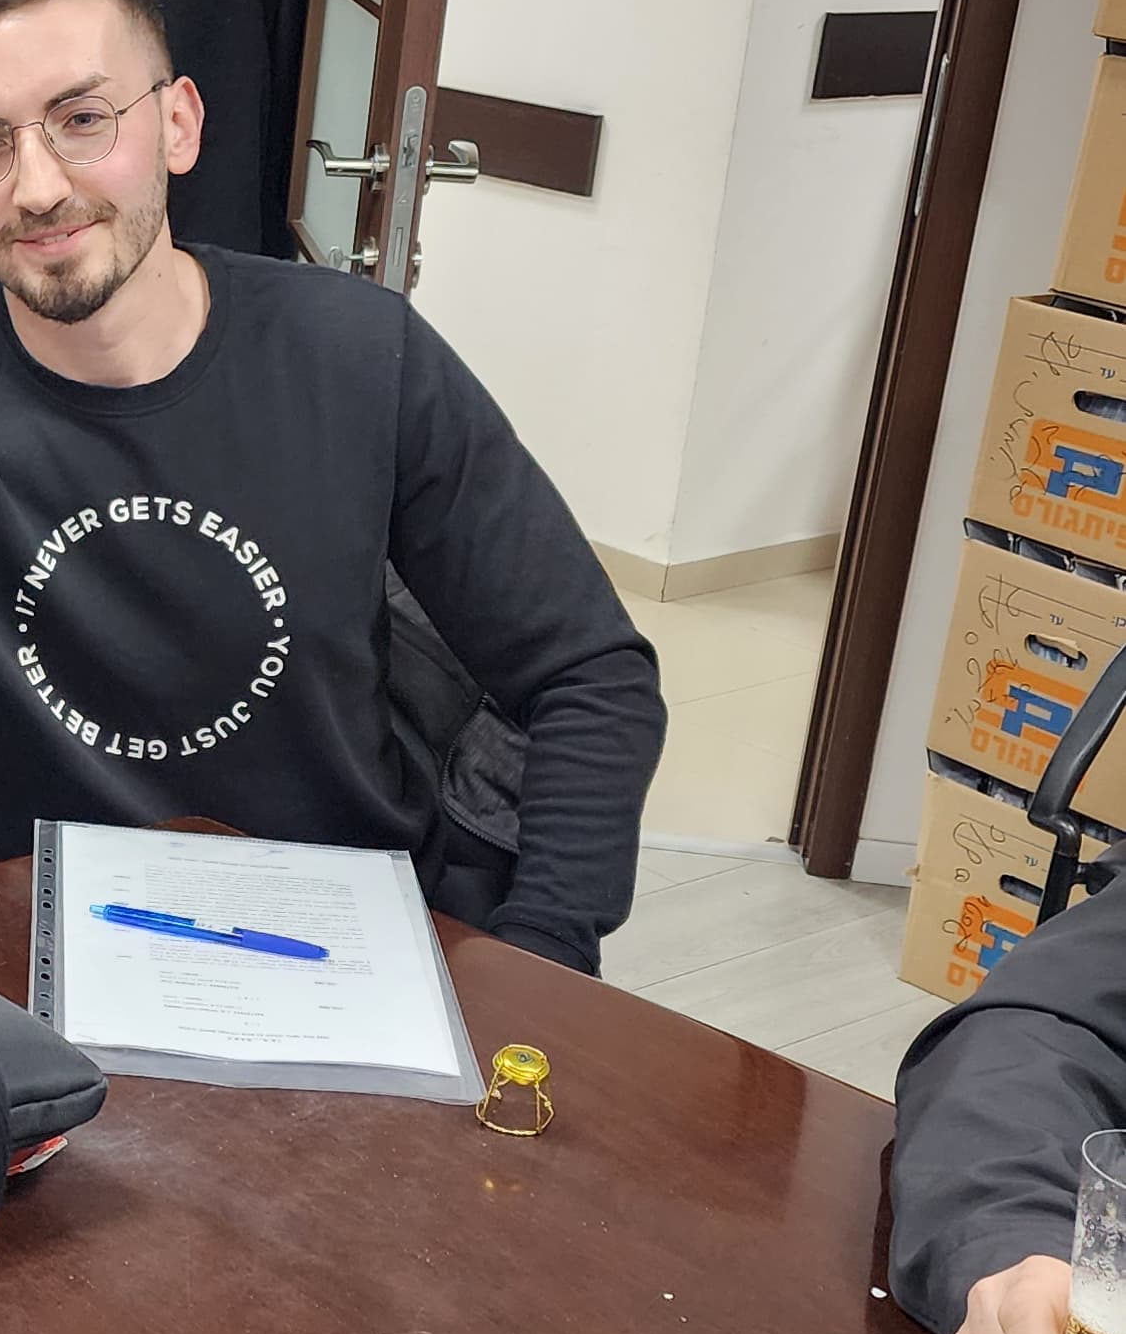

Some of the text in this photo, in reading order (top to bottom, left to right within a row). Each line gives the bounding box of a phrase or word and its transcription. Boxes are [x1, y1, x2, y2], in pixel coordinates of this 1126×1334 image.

[1100, 366, 1116, 380] עד
[15, 496, 287, 616] IT NEVER GETS EASIER
[1049, 613, 1065, 626] עד
[17, 635, 291, 761] YOU JUST GET BETTER
[1023, 855, 1039, 867] עד
